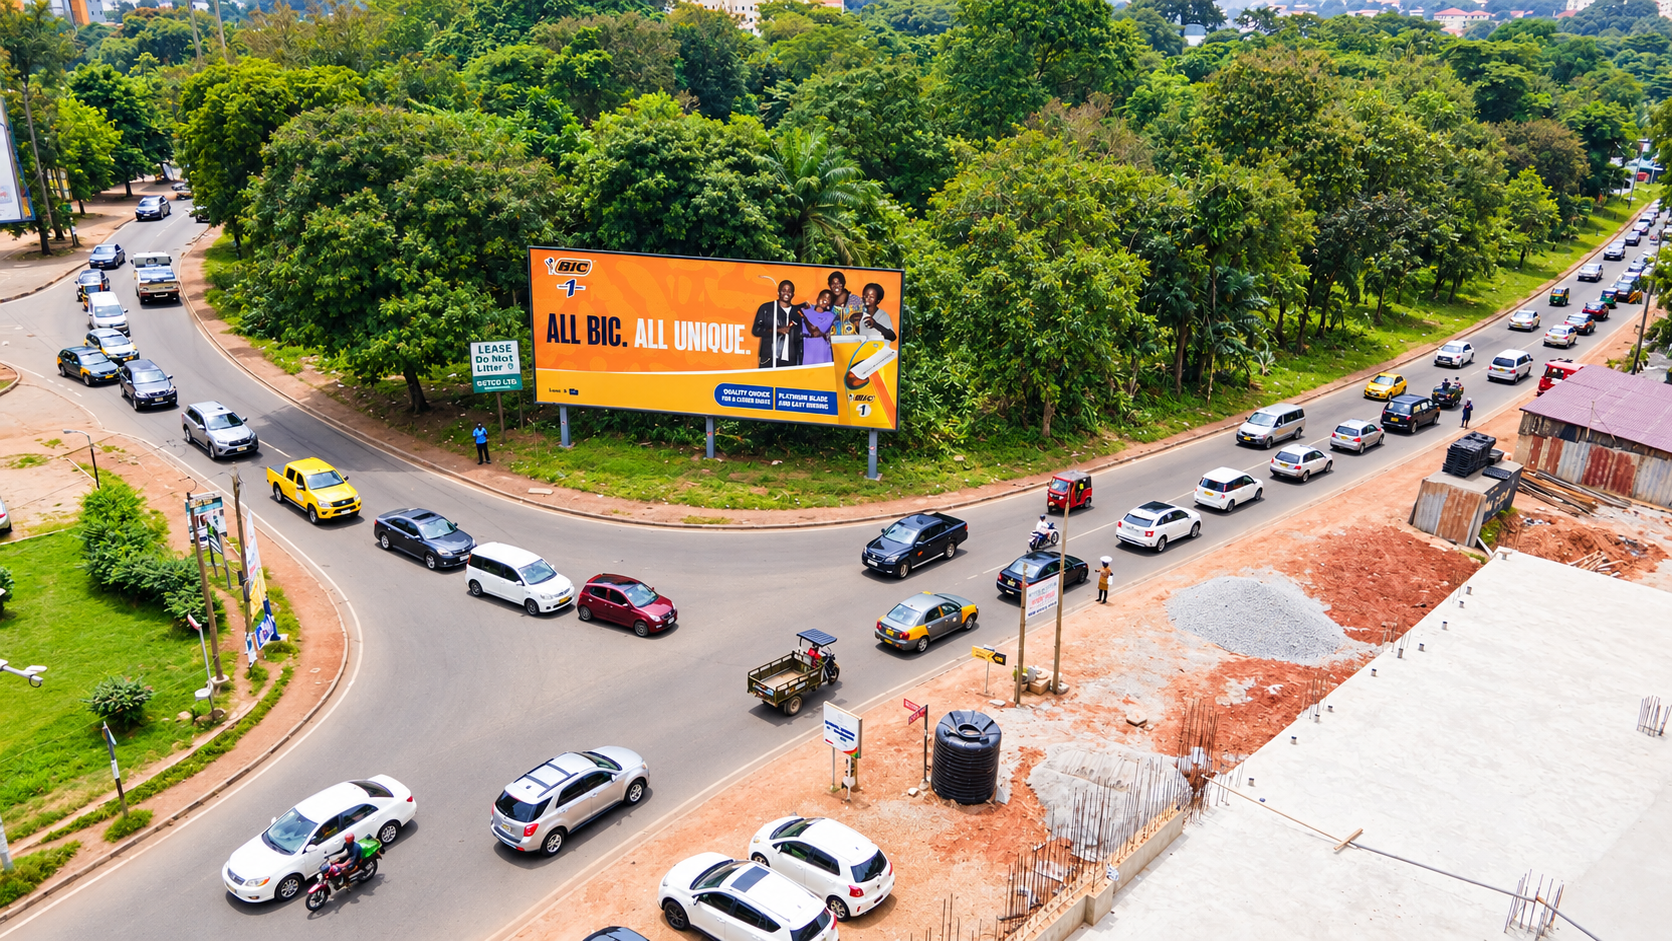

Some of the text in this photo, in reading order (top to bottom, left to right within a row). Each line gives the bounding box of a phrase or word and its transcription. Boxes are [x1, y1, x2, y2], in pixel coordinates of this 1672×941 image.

[557, 261, 589, 273] BIC
[565, 279, 576, 297] 1
[546, 312, 751, 355] ALL BIC. ALL UNIQUE.
[478, 344, 512, 354] LEASE
